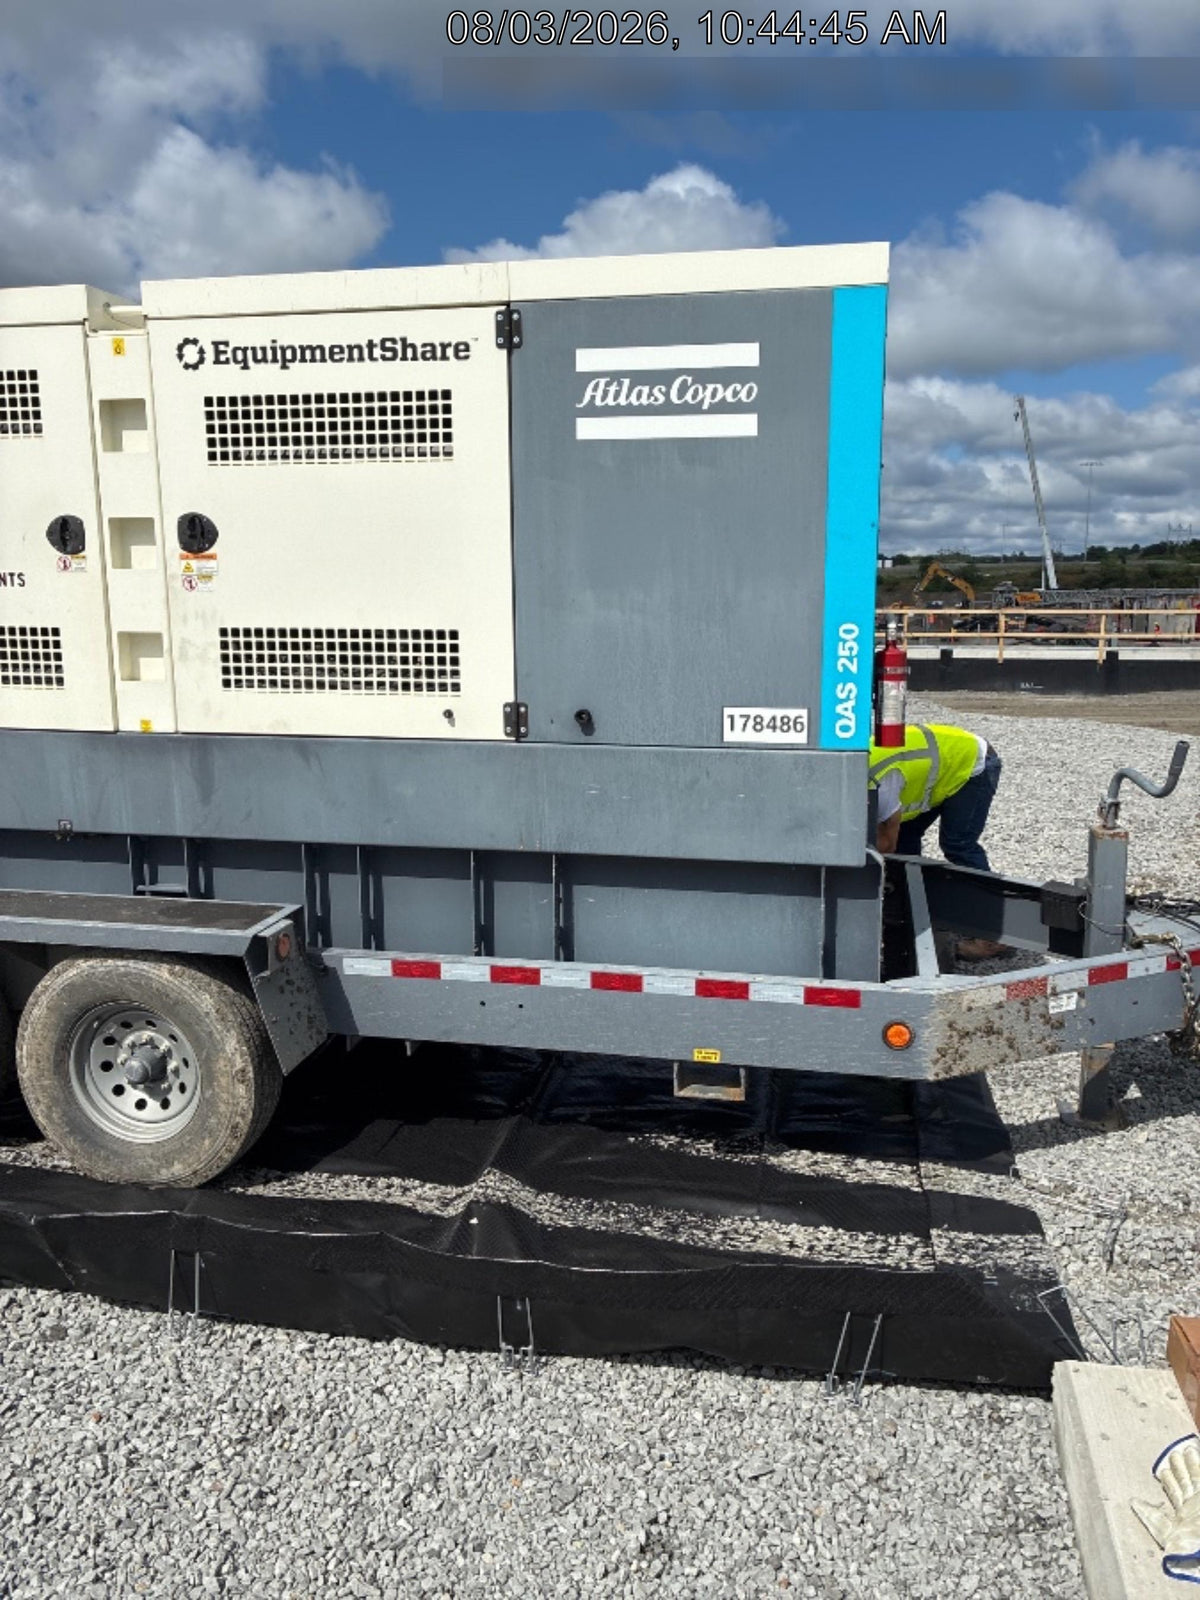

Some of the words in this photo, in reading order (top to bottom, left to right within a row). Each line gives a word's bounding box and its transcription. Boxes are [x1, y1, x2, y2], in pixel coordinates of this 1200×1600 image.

[211, 337, 471, 371] EquipmentShare
[576, 377, 667, 408] Atlas
[669, 375, 758, 410] Copco
[0, 571, 26, 588] NTS
[837, 623, 860, 674] 250
[727, 714, 805, 733] 178486
